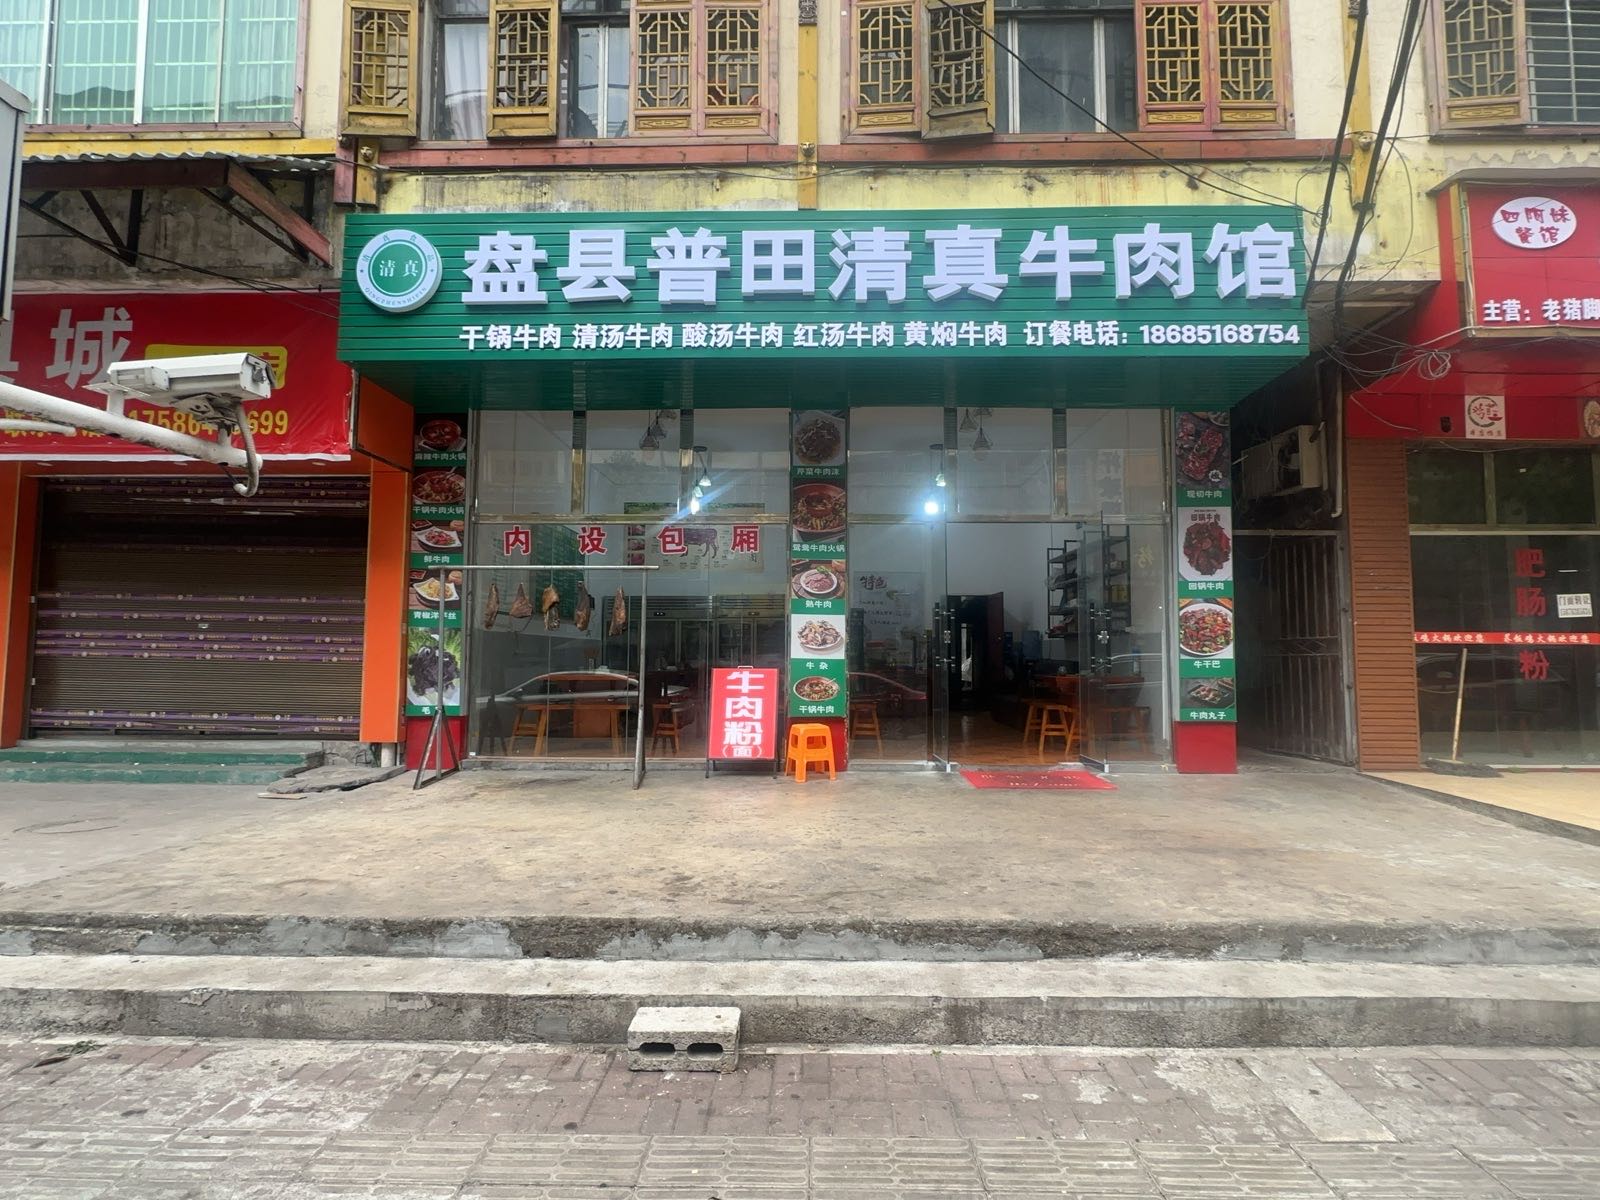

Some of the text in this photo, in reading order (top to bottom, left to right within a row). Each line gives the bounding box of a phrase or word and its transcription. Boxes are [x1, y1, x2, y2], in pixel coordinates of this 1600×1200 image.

[1515, 226, 1560, 243] 餐馆
[379, 259, 419, 277] 清真
[461, 222, 1297, 307] 盘县普田清真牛肉馆
[459, 324, 562, 350] 干锅牛肉
[571, 323, 673, 349] 清汤牛肉
[681, 322, 784, 348] 酸汤牛肉
[793, 321, 895, 348] 红汤牛肉
[903, 320, 1008, 347] 黄焖牛肉
[0, 306, 134, 391] 城
[504, 524, 760, 556] 内设包厢
[792, 544, 846, 552] 鸳鸯牛肉火锅
[423, 555, 450, 563] 鲜牛肉
[1188, 582, 1225, 591] 回锅牛肉
[805, 600, 832, 609] 熟牛肉
[805, 661, 829, 670] 牛杂
[1193, 660, 1221, 669] 牛干巴
[799, 705, 835, 714] 干锅牛肉
[1189, 711, 1227, 720] 牛肉丸子
